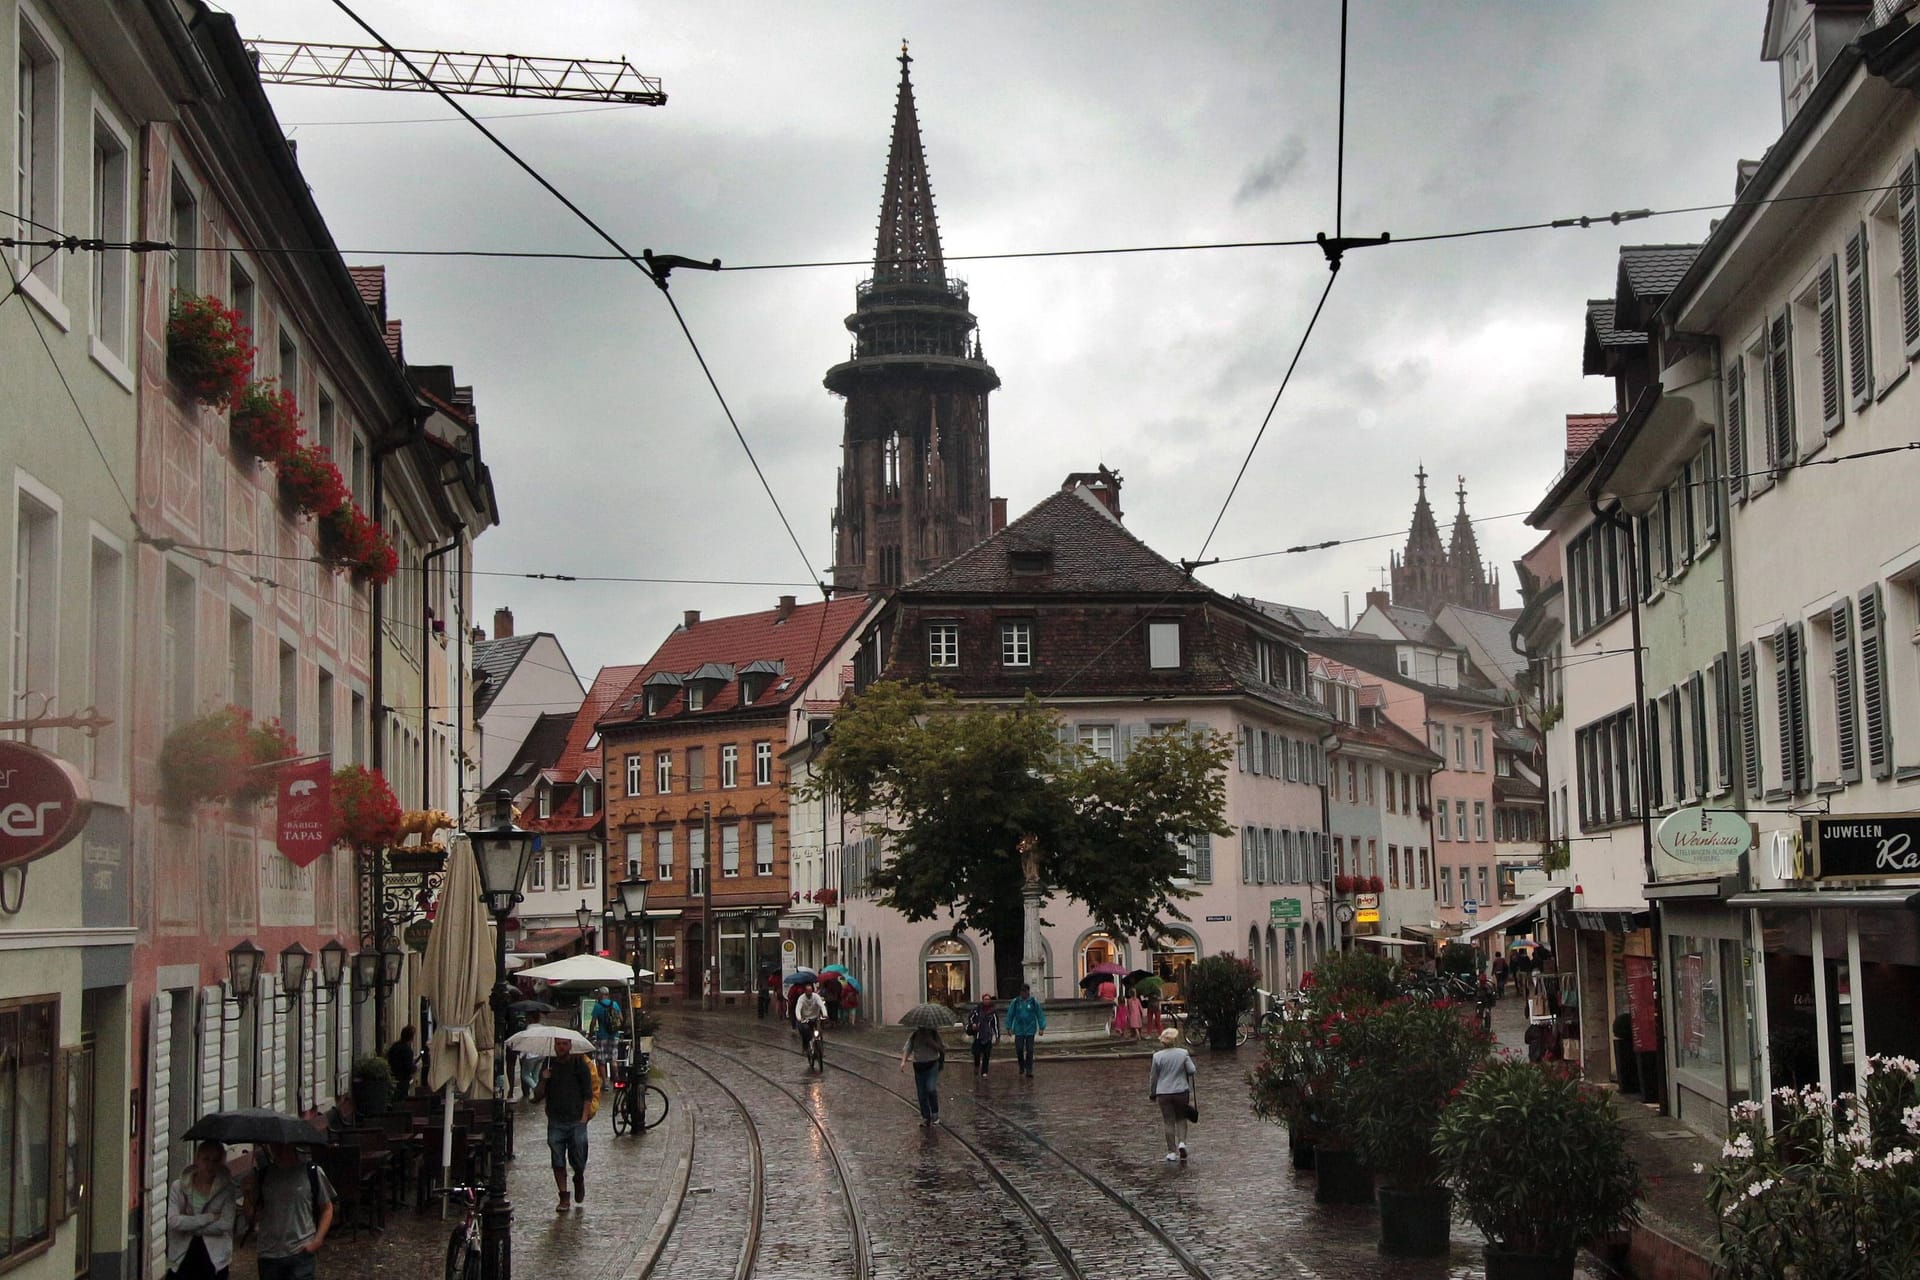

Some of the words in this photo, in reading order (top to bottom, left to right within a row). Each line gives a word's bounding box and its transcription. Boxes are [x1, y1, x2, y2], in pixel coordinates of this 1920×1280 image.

[283, 831, 322, 840] TAPAS
[1674, 831, 1740, 847] Weinhaus
[1824, 825, 1882, 839] JUWELEN
[261, 854, 288, 889] HOTEL
